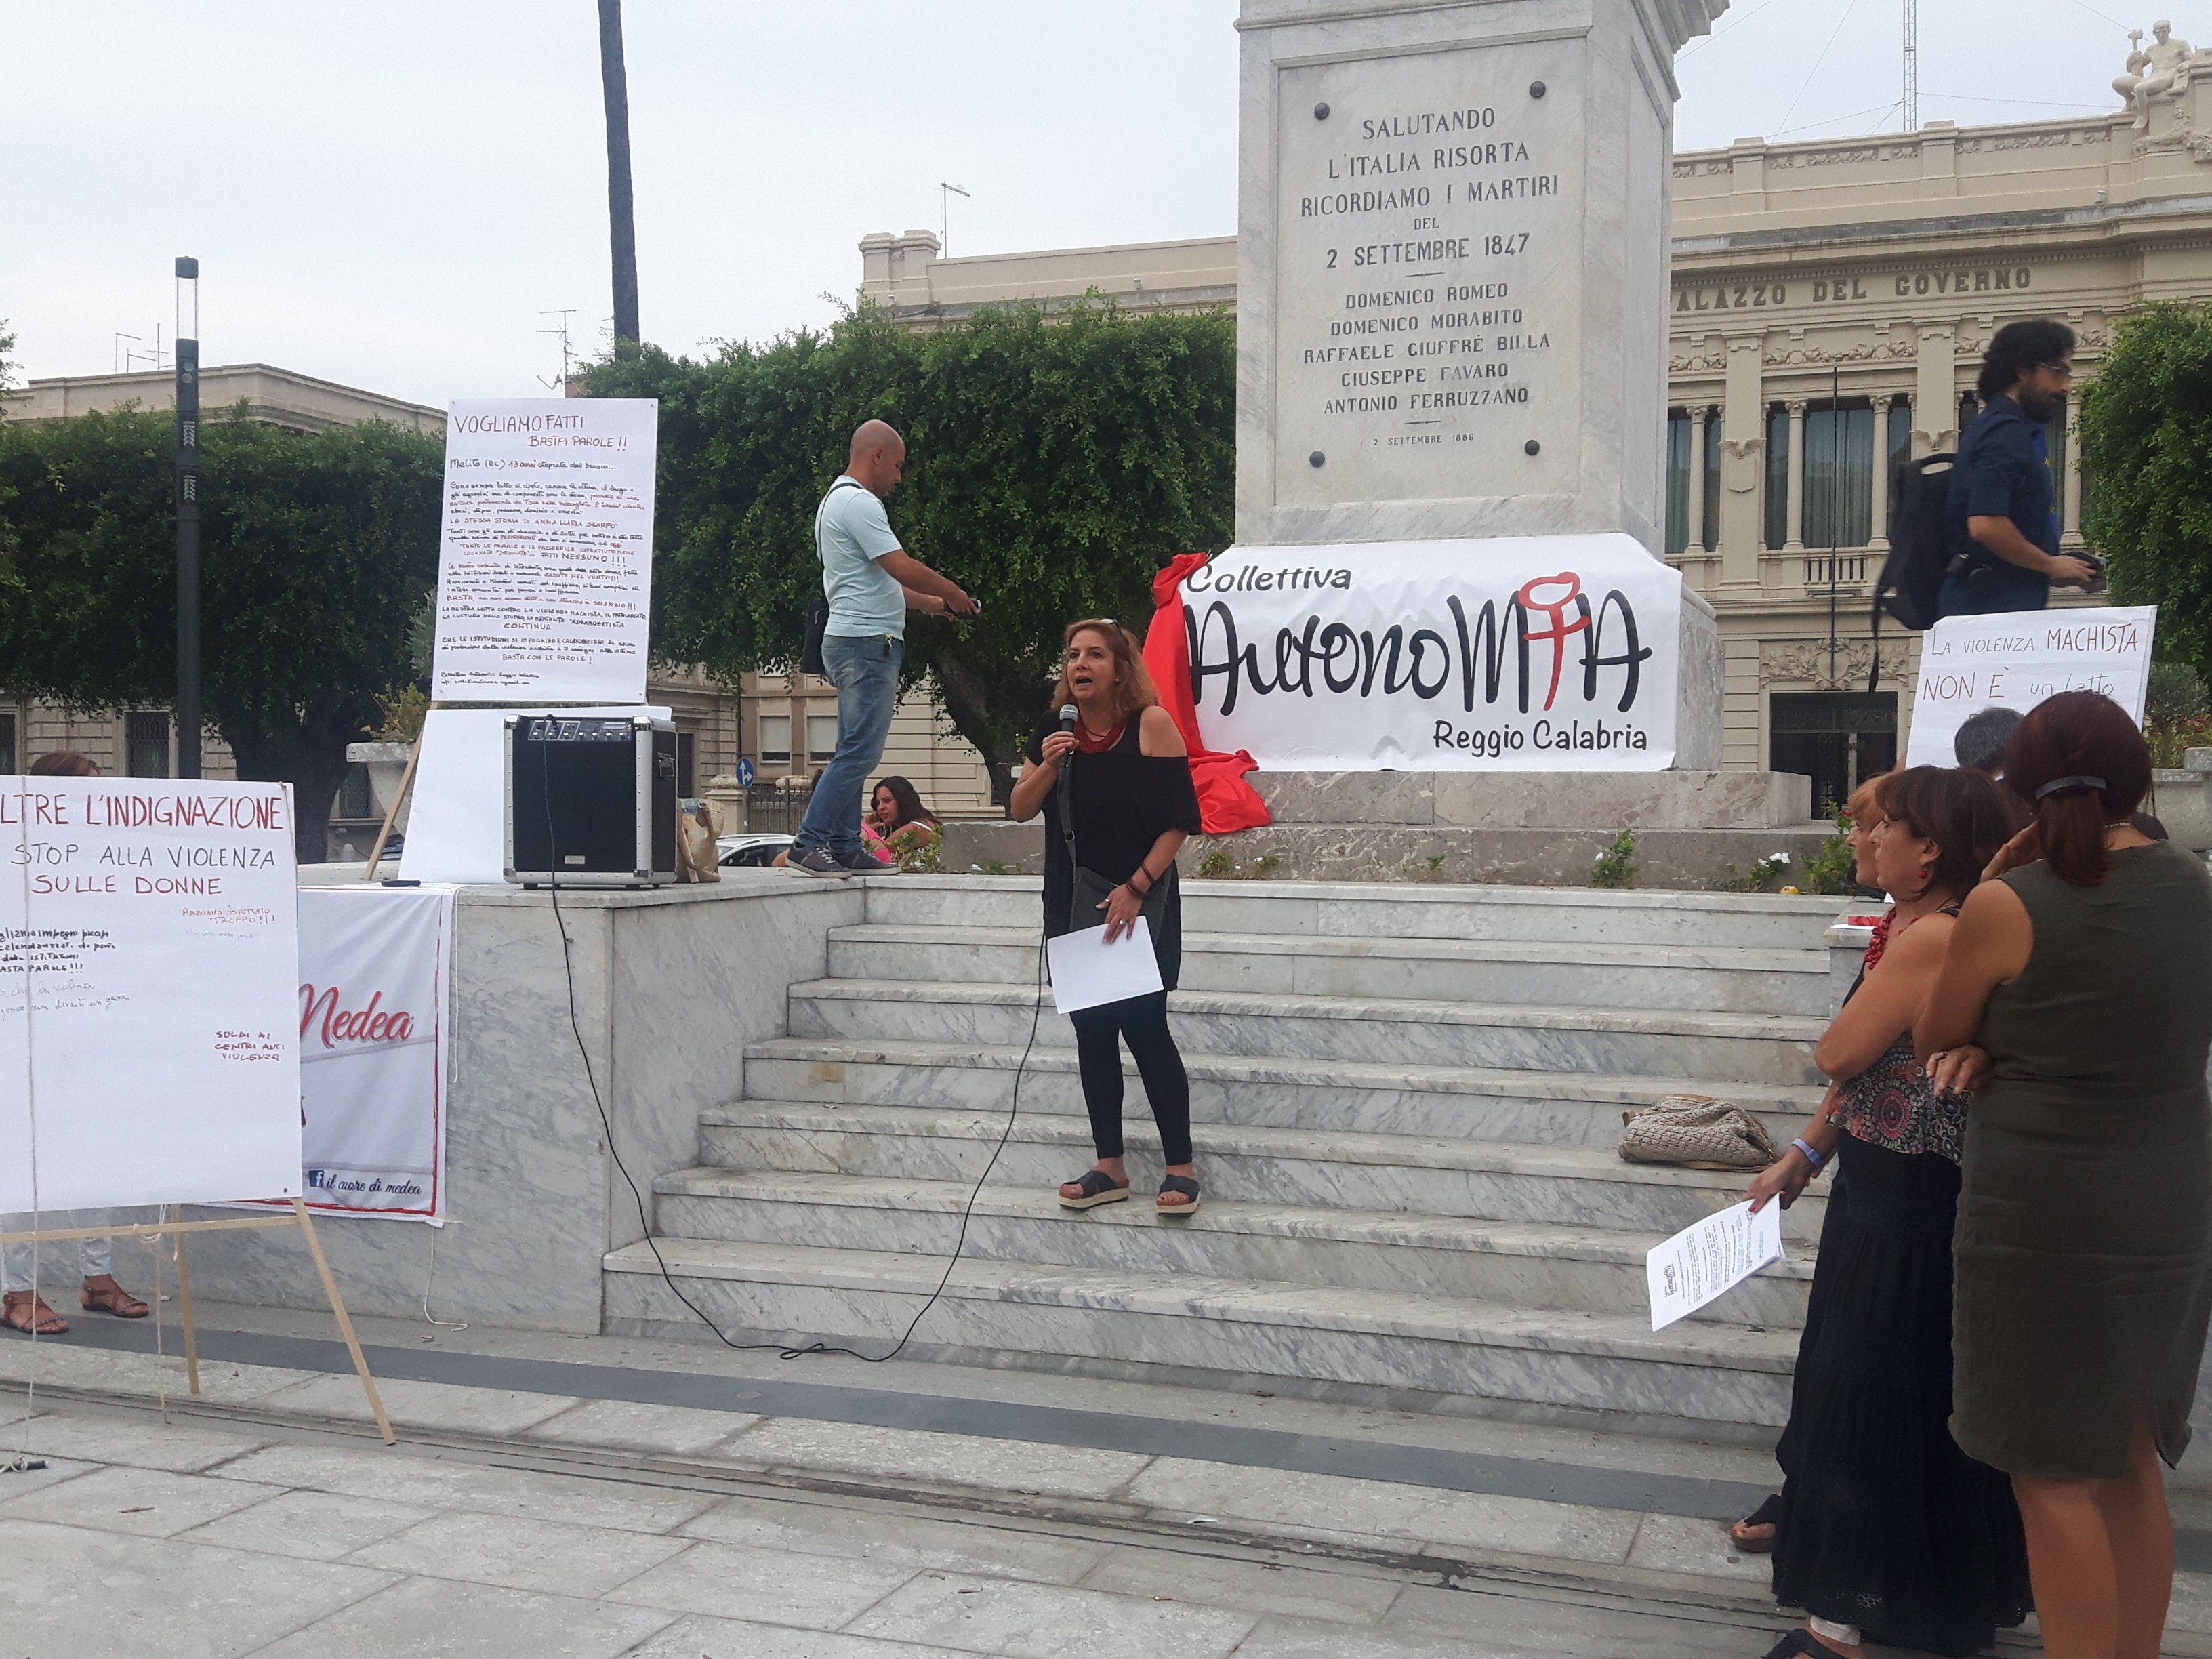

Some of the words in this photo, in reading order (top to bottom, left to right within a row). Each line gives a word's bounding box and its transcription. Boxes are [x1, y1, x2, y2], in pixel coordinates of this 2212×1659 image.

[1362, 107, 1496, 140] SALUTANDO
[1328, 152, 1421, 179] L'ITALIA
[1433, 142, 1530, 169] RISORTA
[1300, 186, 1430, 217] RICORDIAMO
[1446, 184, 1452, 205] I
[1467, 173, 1559, 203] MARTIRI
[1414, 217, 1440, 230] DEL
[1326, 249, 1338, 269] 2
[1354, 237, 1471, 266] SETTEMBRE
[1484, 232, 1531, 256] 1847
[1345, 288, 1435, 310] DOMENICO
[1446, 282, 1509, 302] ROMEO
[1671, 283, 1787, 312] ALAZZO
[1811, 279, 1867, 302] DEL
[1894, 267, 2032, 297] GOVERNO
[1330, 316, 1419, 336] DOMENICO
[1431, 308, 1523, 329] MORABITO
[1303, 344, 1395, 365] RAFFAELE
[1496, 333, 1551, 352] BILLA
[1340, 368, 1427, 388] GIUSEPPE
[1440, 363, 1509, 382] FAVARO
[1324, 396, 1398, 415] ANTONIO
[1410, 387, 1529, 409] FERRUZZANO
[454, 415, 542, 433] VOGLIAMO
[545, 415, 583, 430] FATTI
[528, 436, 568, 447] BASTA
[573, 436, 614, 448] PAROLE
[1372, 438, 1378, 447] 2
[1387, 434, 1443, 447] SETTEMBRE
[450, 458, 480, 469] Melito
[485, 458, 506, 470] (RC)
[562, 553, 608, 562] NESSUNO
[1185, 562, 1353, 594] Collettiva
[504, 623, 552, 631] CONTINUA
[1963, 636, 2034, 653] VIOLENZA
[2046, 622, 2139, 655] MACHISTA
[557, 654, 586, 662] PAROLE
[1923, 672, 1976, 701] NON
[2030, 682, 2053, 696] un
[1434, 719, 1525, 758] Reggio
[1532, 718, 1647, 751] Calabria
[86, 794, 284, 830] L'INDIGNAZIONE
[10, 842, 79, 865] STOP
[99, 846, 153, 867] ALLA
[167, 846, 276, 869] VIOLENZA
[30, 874, 118, 895] SULLE
[135, 876, 222, 895] DONNE
[28, 964, 68, 972] PAROLE
[298, 982, 415, 1050] Medea
[213, 1042, 257, 1050] CENTRI
[326, 1174, 337, 1189] il
[337, 1180, 366, 1193] cuore
[369, 1177, 383, 1193] di
[384, 1179, 422, 1195] medea
